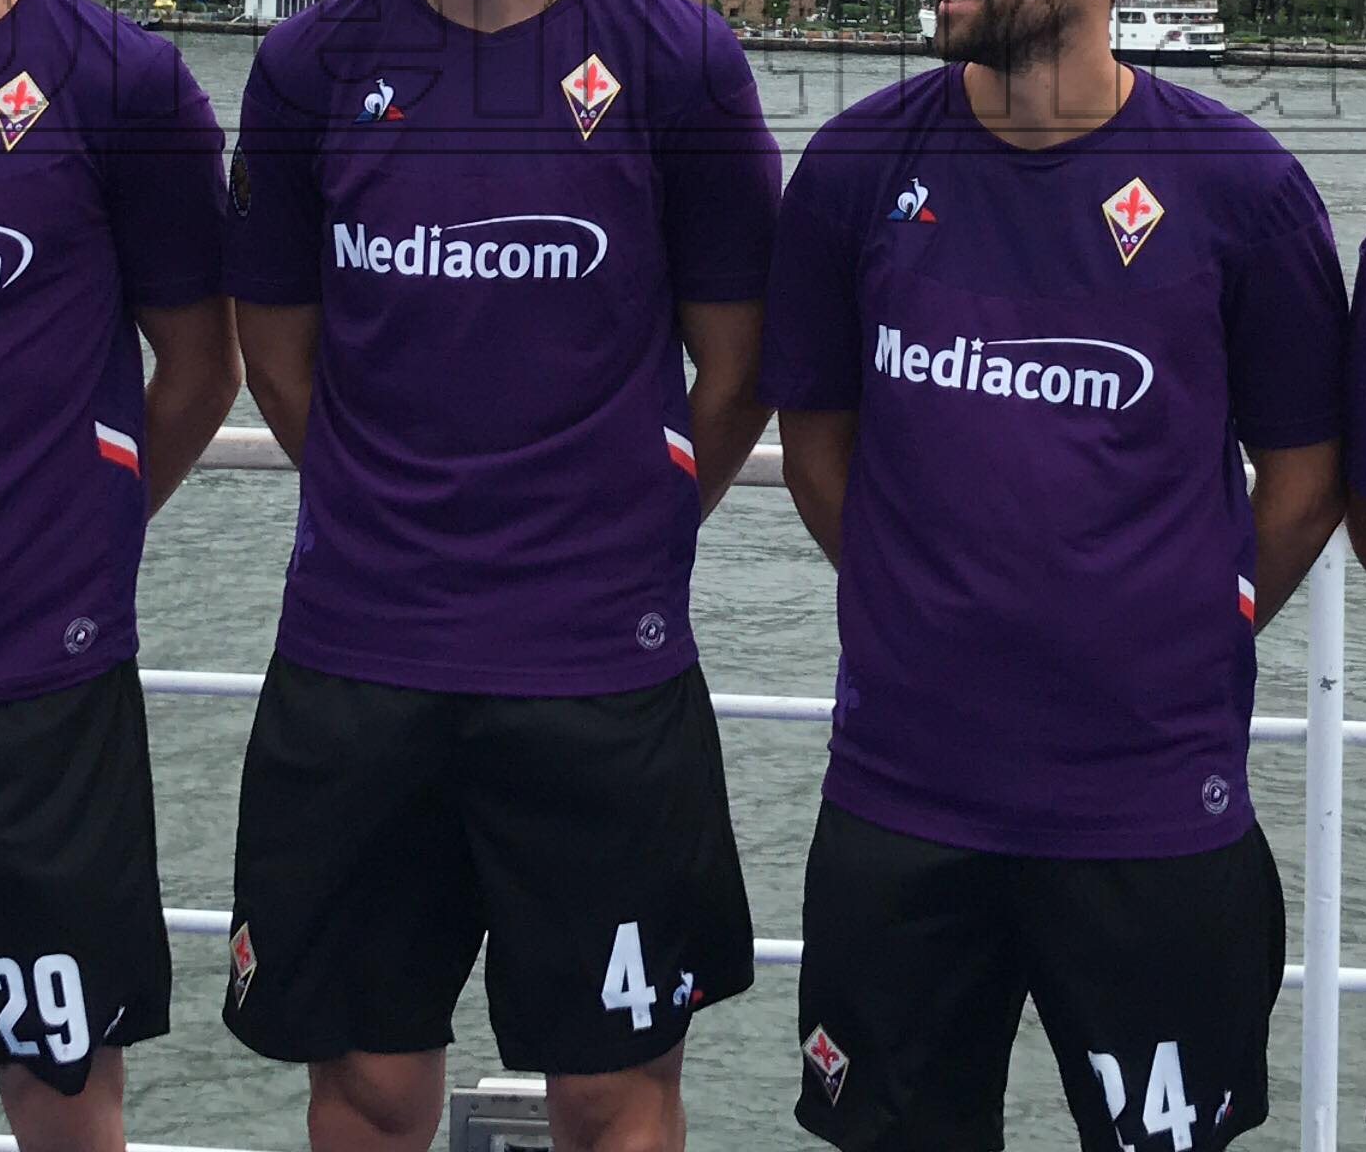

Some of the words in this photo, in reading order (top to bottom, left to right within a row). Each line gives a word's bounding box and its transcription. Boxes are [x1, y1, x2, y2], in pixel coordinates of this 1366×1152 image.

[333, 222, 579, 279] Mediacom
[874, 324, 1121, 411] Mediacom
[601, 920, 657, 1032] 4
